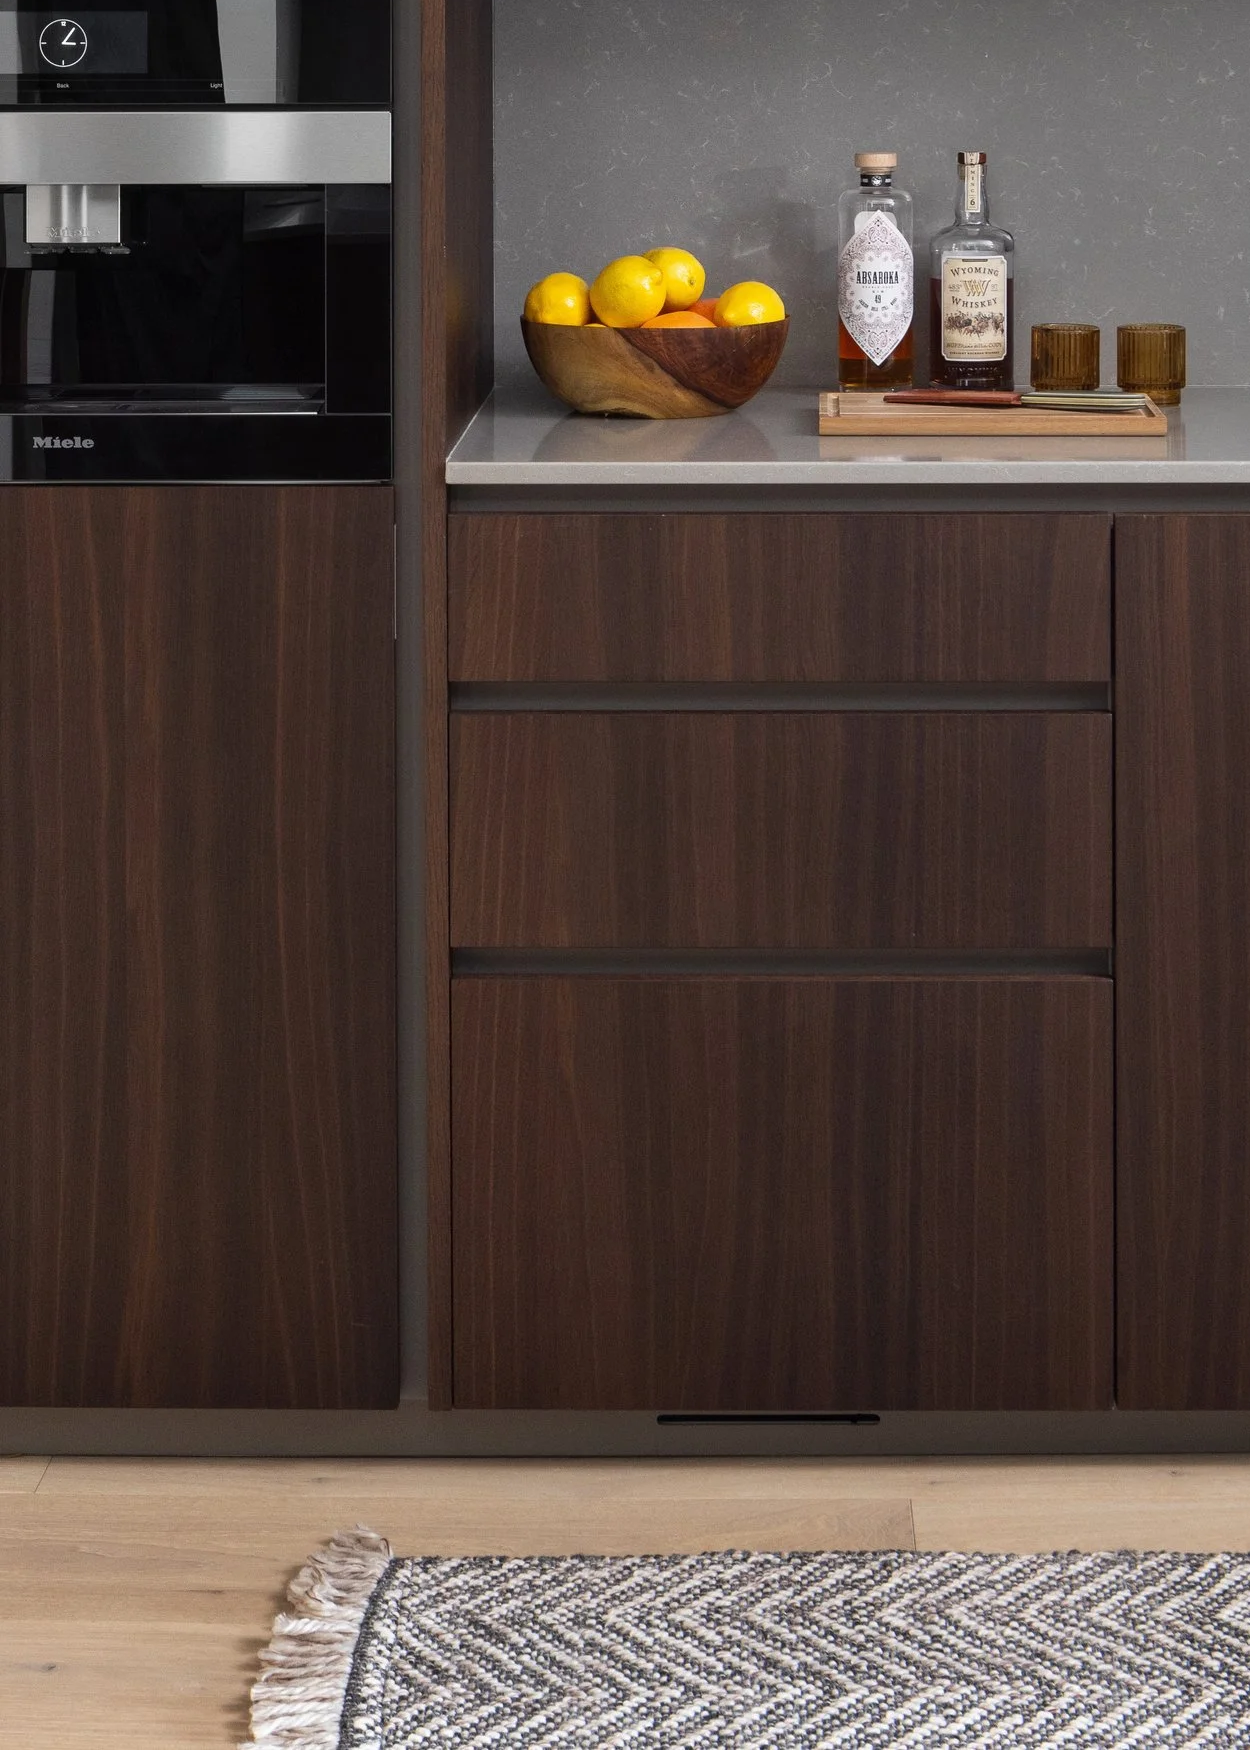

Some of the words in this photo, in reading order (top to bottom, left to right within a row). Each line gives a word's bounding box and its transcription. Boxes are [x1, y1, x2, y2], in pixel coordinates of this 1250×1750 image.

[856, 271, 899, 284] ABSAROKA
[950, 266, 1000, 277] WYOMING
[951, 296, 998, 308] WHISKEY
[32, 436, 95, 448] Miele
